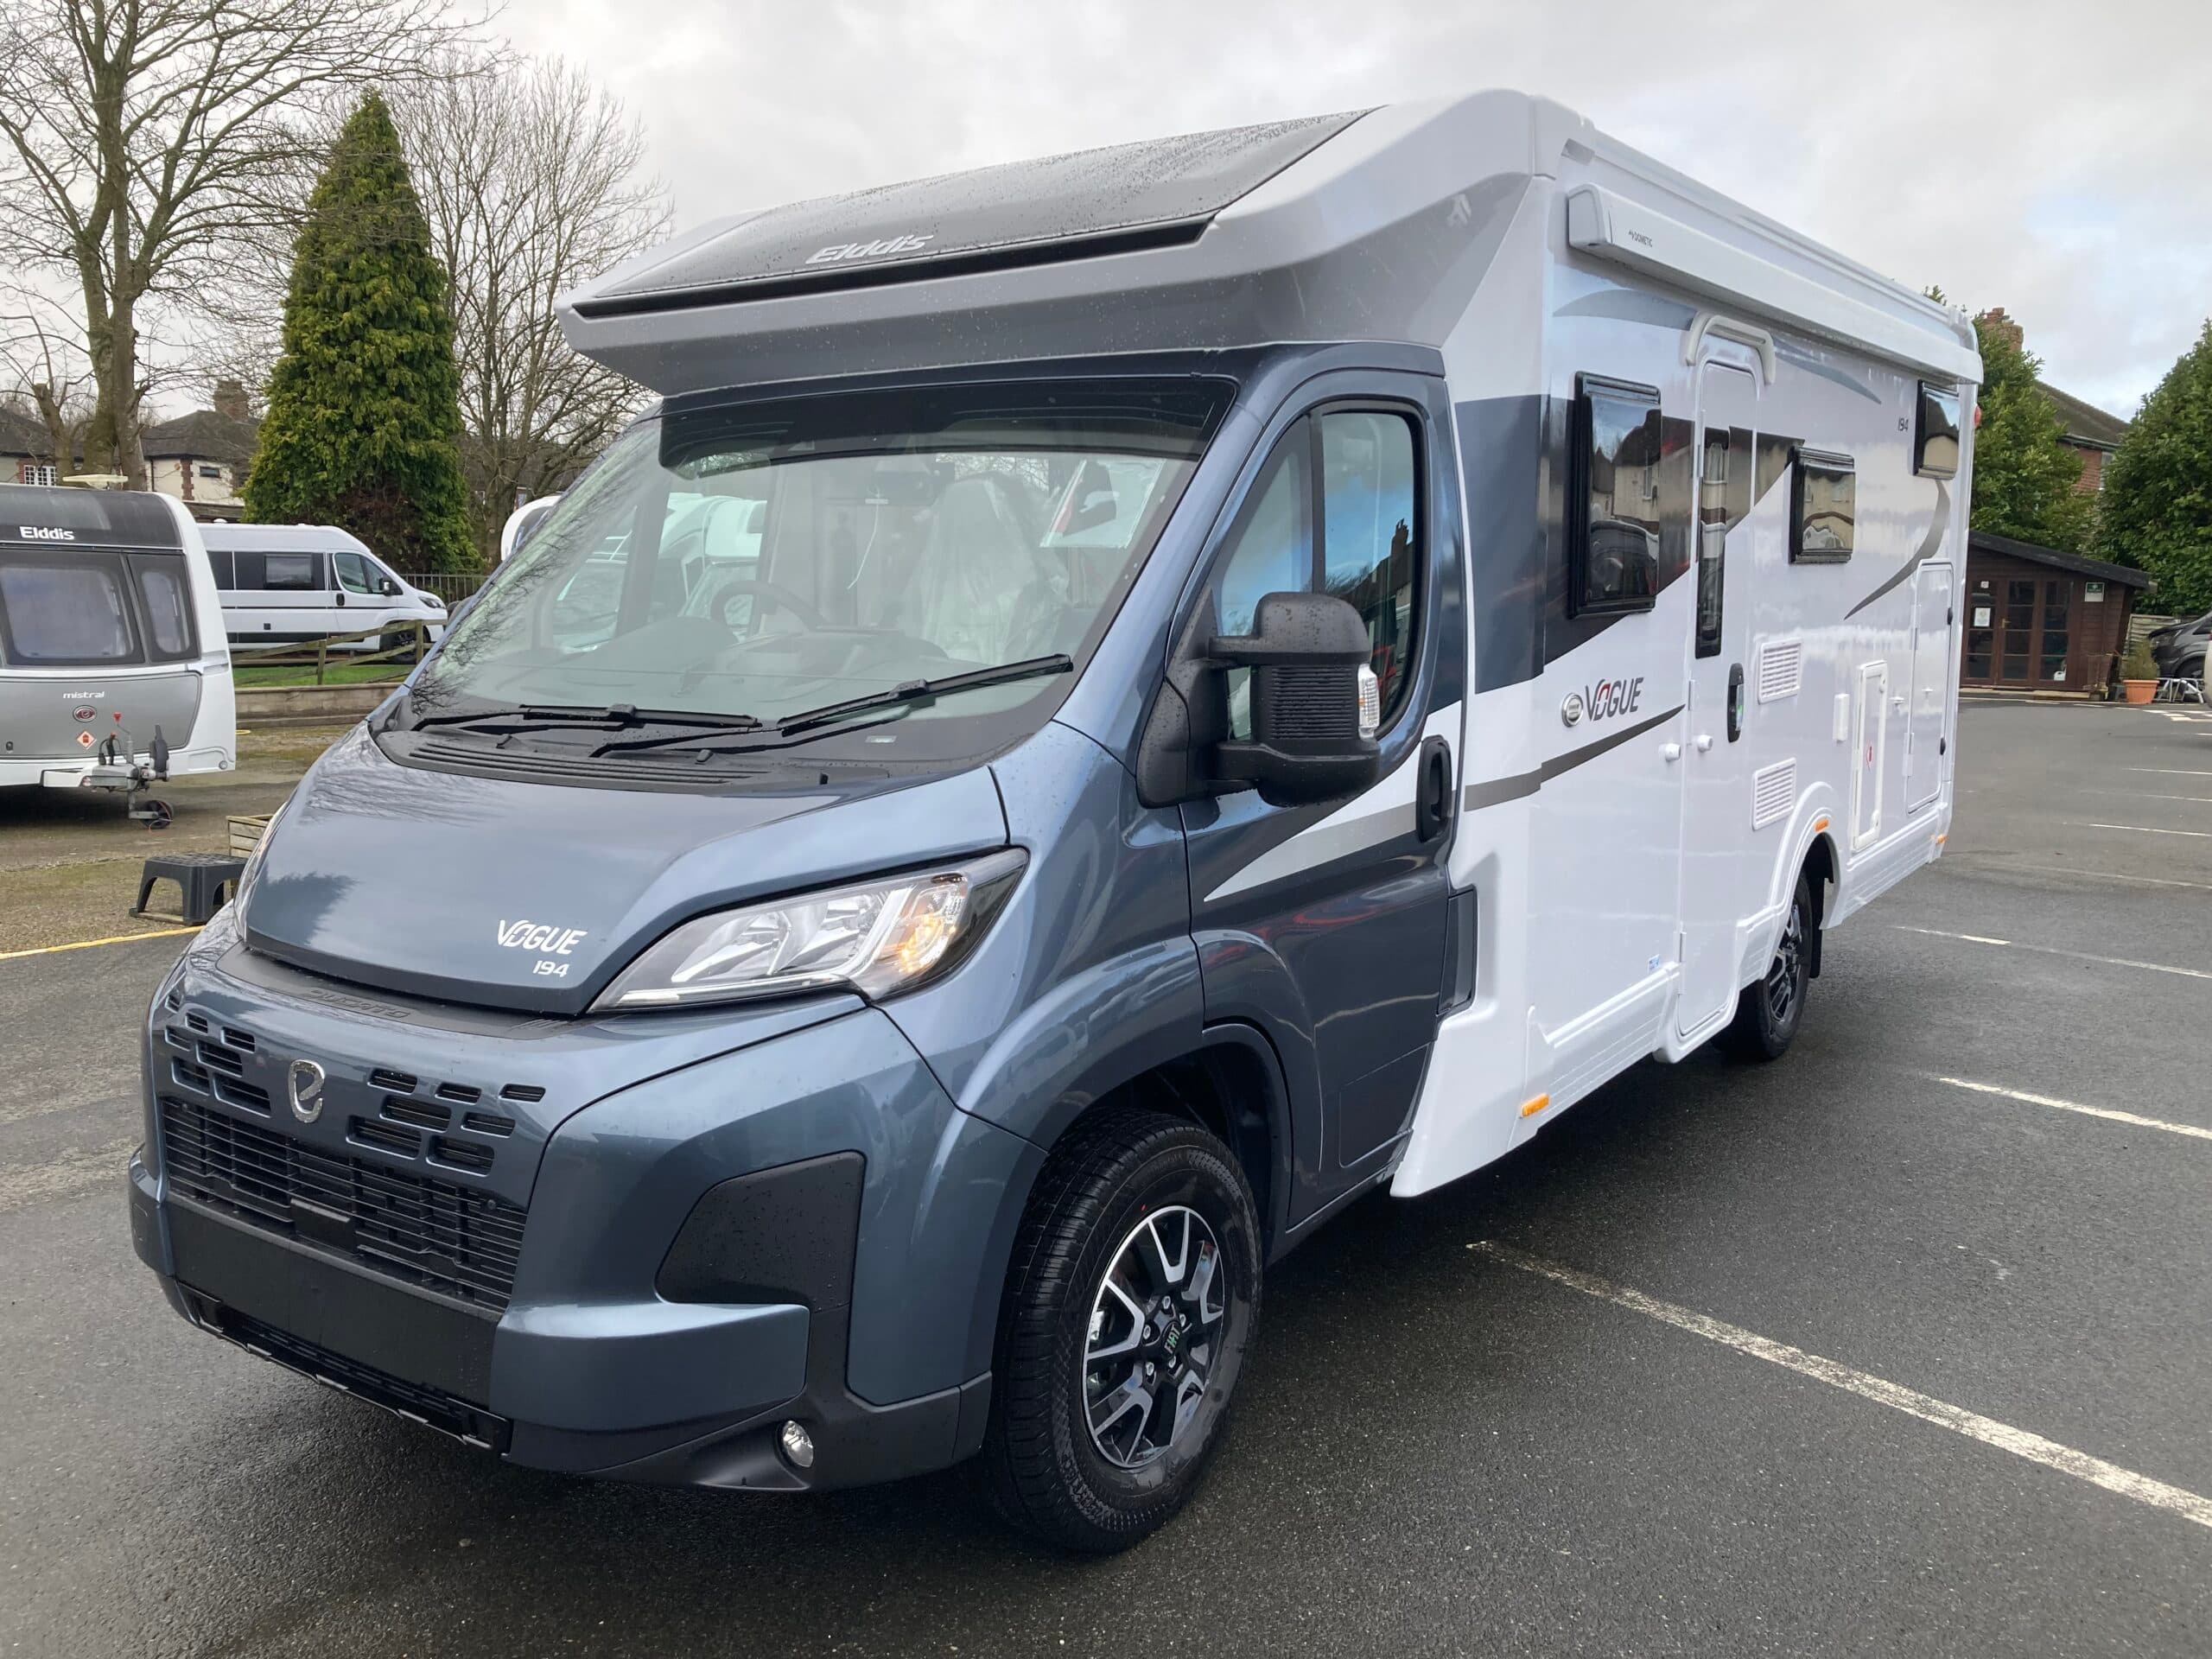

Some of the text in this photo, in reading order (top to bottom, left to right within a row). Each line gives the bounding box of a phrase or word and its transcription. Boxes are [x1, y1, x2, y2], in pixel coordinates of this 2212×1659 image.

[804, 234, 934, 264] Elddis
[19, 525, 75, 541] Elddis
[62, 690, 105, 699] mistral
[1585, 677, 1644, 722] VOGUE
[497, 919, 588, 955] VOGUE
[532, 960, 570, 978] 194
[1164, 1324, 1180, 1355] FIAT
